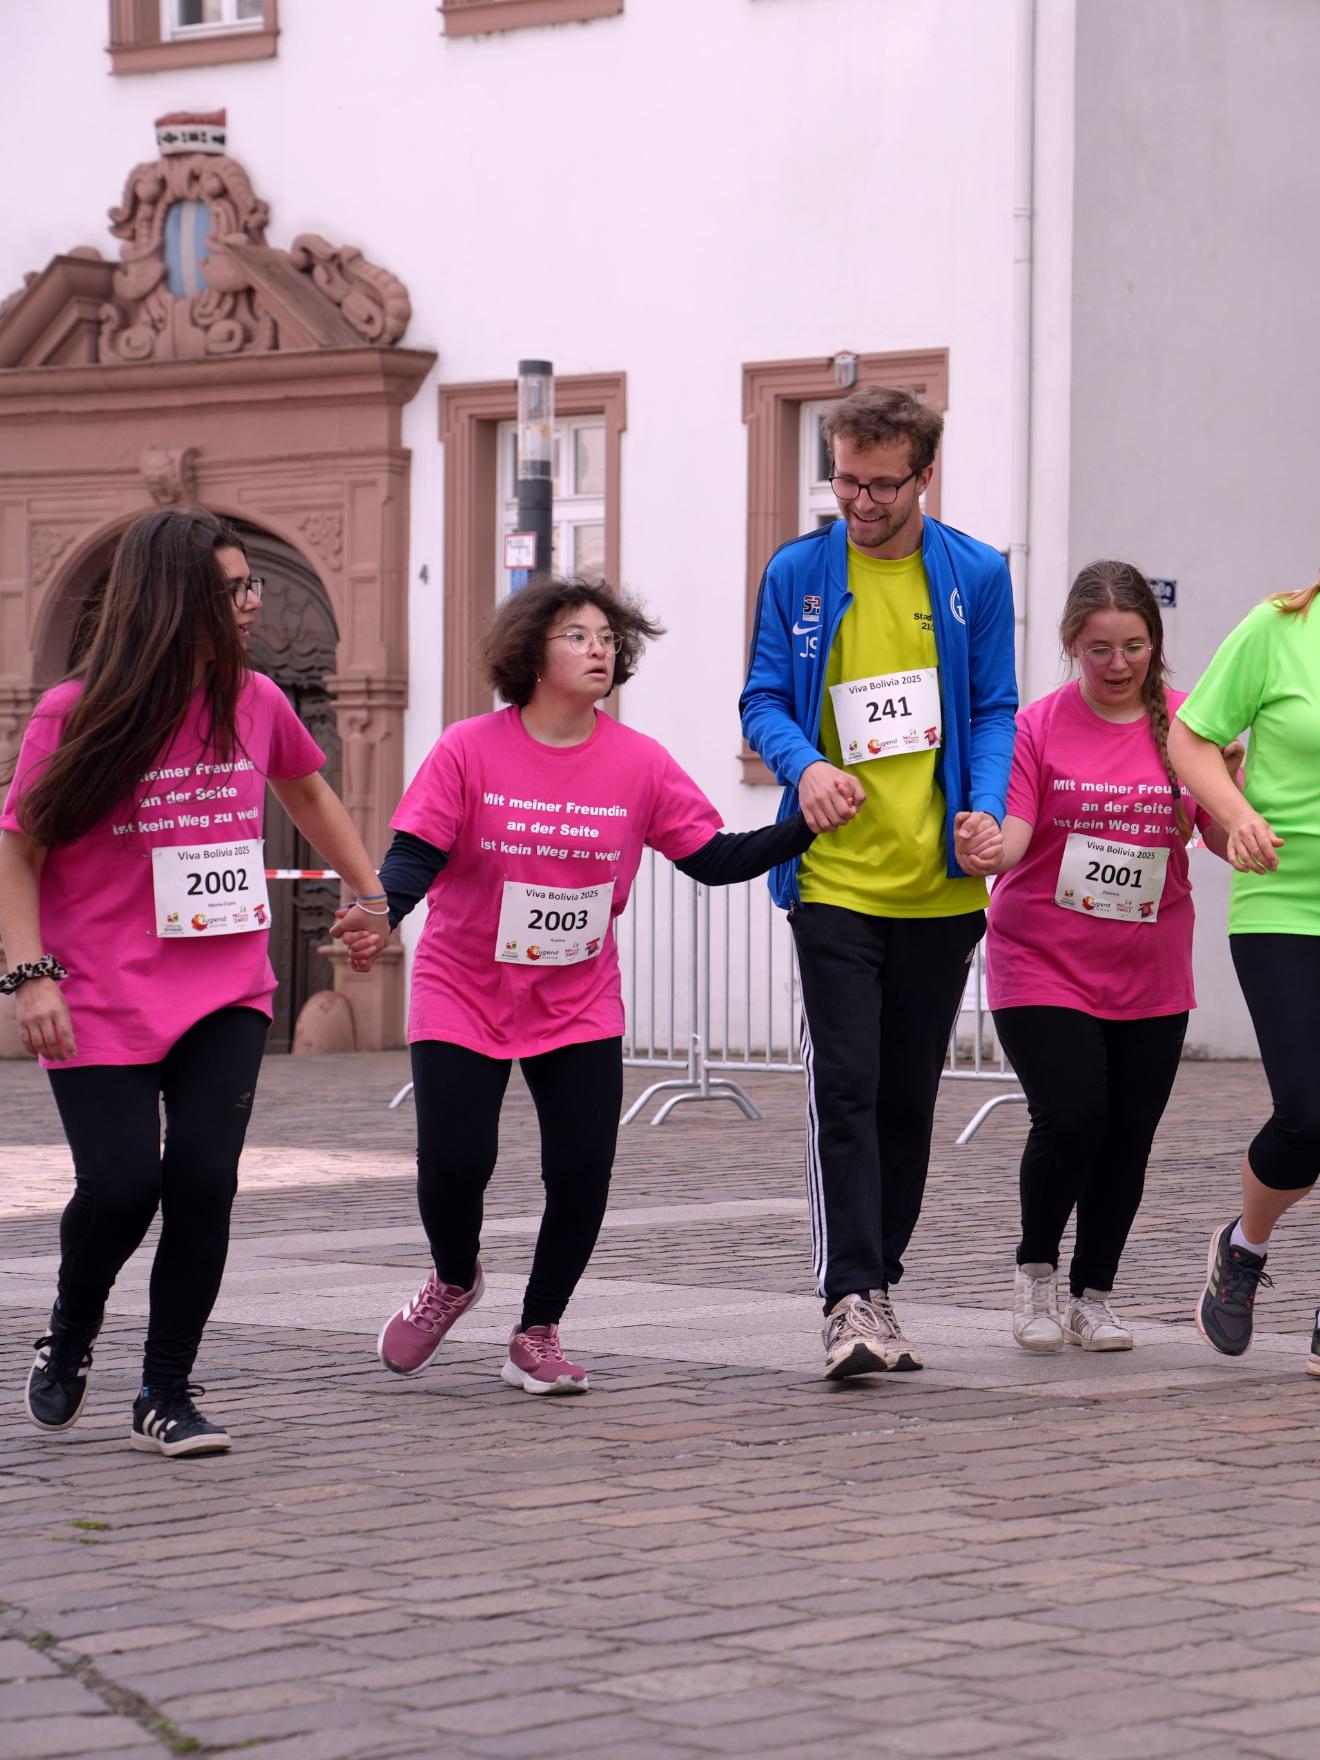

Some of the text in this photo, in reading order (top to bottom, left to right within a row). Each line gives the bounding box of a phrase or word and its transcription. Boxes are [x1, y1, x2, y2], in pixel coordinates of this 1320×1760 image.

[913, 612, 932, 621] Stad
[848, 674, 922, 695] Viva Bolivia 2025
[866, 696, 912, 723] 241
[1053, 779, 1076, 791] Mit
[1081, 782, 1134, 794] meiner
[140, 787, 238, 808] an der Seite
[483, 792, 628, 817] Mit meiner Freundin
[1081, 801, 1173, 815] an der Seite
[112, 824, 135, 836] ist
[138, 818, 175, 833] kein
[178, 814, 210, 828] Weg
[214, 812, 232, 824] zu
[506, 821, 600, 838] an der Seite
[1053, 817, 1072, 828] ist
[1073, 818, 1104, 830] kein
[1108, 820, 1140, 834] Weg
[1143, 824, 1160, 834] zu
[177, 846, 250, 862] Viva Bolivia 2025
[480, 838, 497, 851] ist
[500, 842, 532, 856] kein
[536, 845, 568, 860] Weg
[572, 849, 589, 859] zu
[1087, 841, 1155, 860] Viva Bolivia 2025
[186, 868, 249, 896] 2002
[1085, 861, 1143, 888] 2001
[526, 888, 599, 902] Viva Bolivia 2025
[527, 909, 588, 932] 2003
